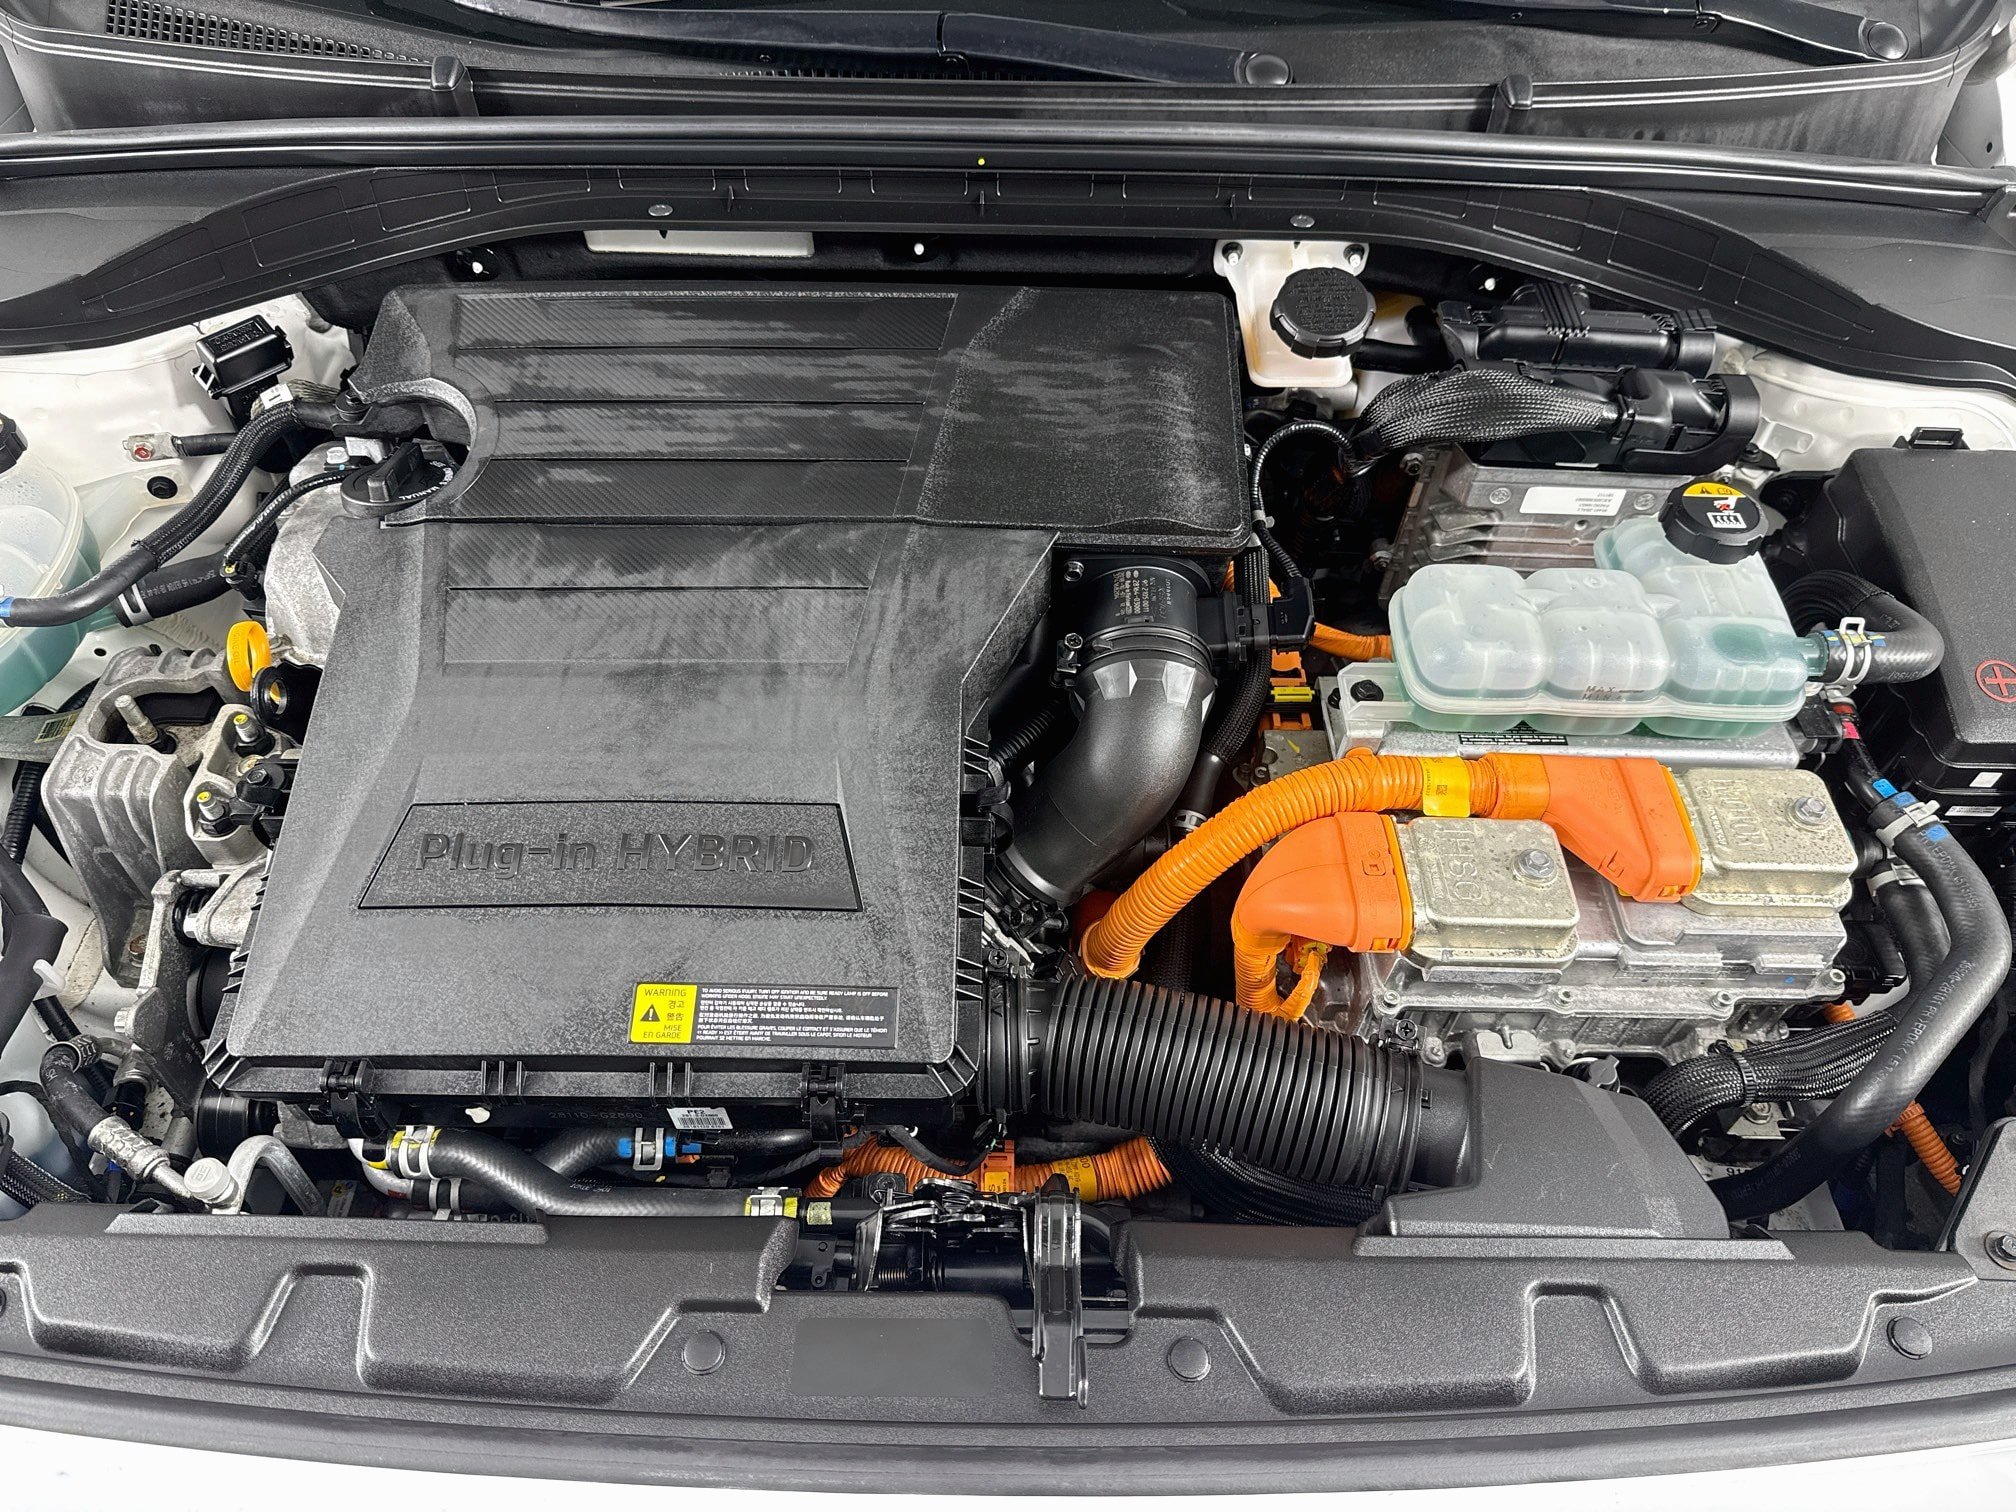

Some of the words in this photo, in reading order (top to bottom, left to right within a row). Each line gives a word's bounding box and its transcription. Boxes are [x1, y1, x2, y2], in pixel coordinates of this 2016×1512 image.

[1586, 685, 1616, 694] MAX
[1582, 693, 1611, 701] MIN
[416, 833, 597, 879] Plug-in
[617, 833, 814, 873] HYBRID
[668, 1000, 685, 1009] 경고
